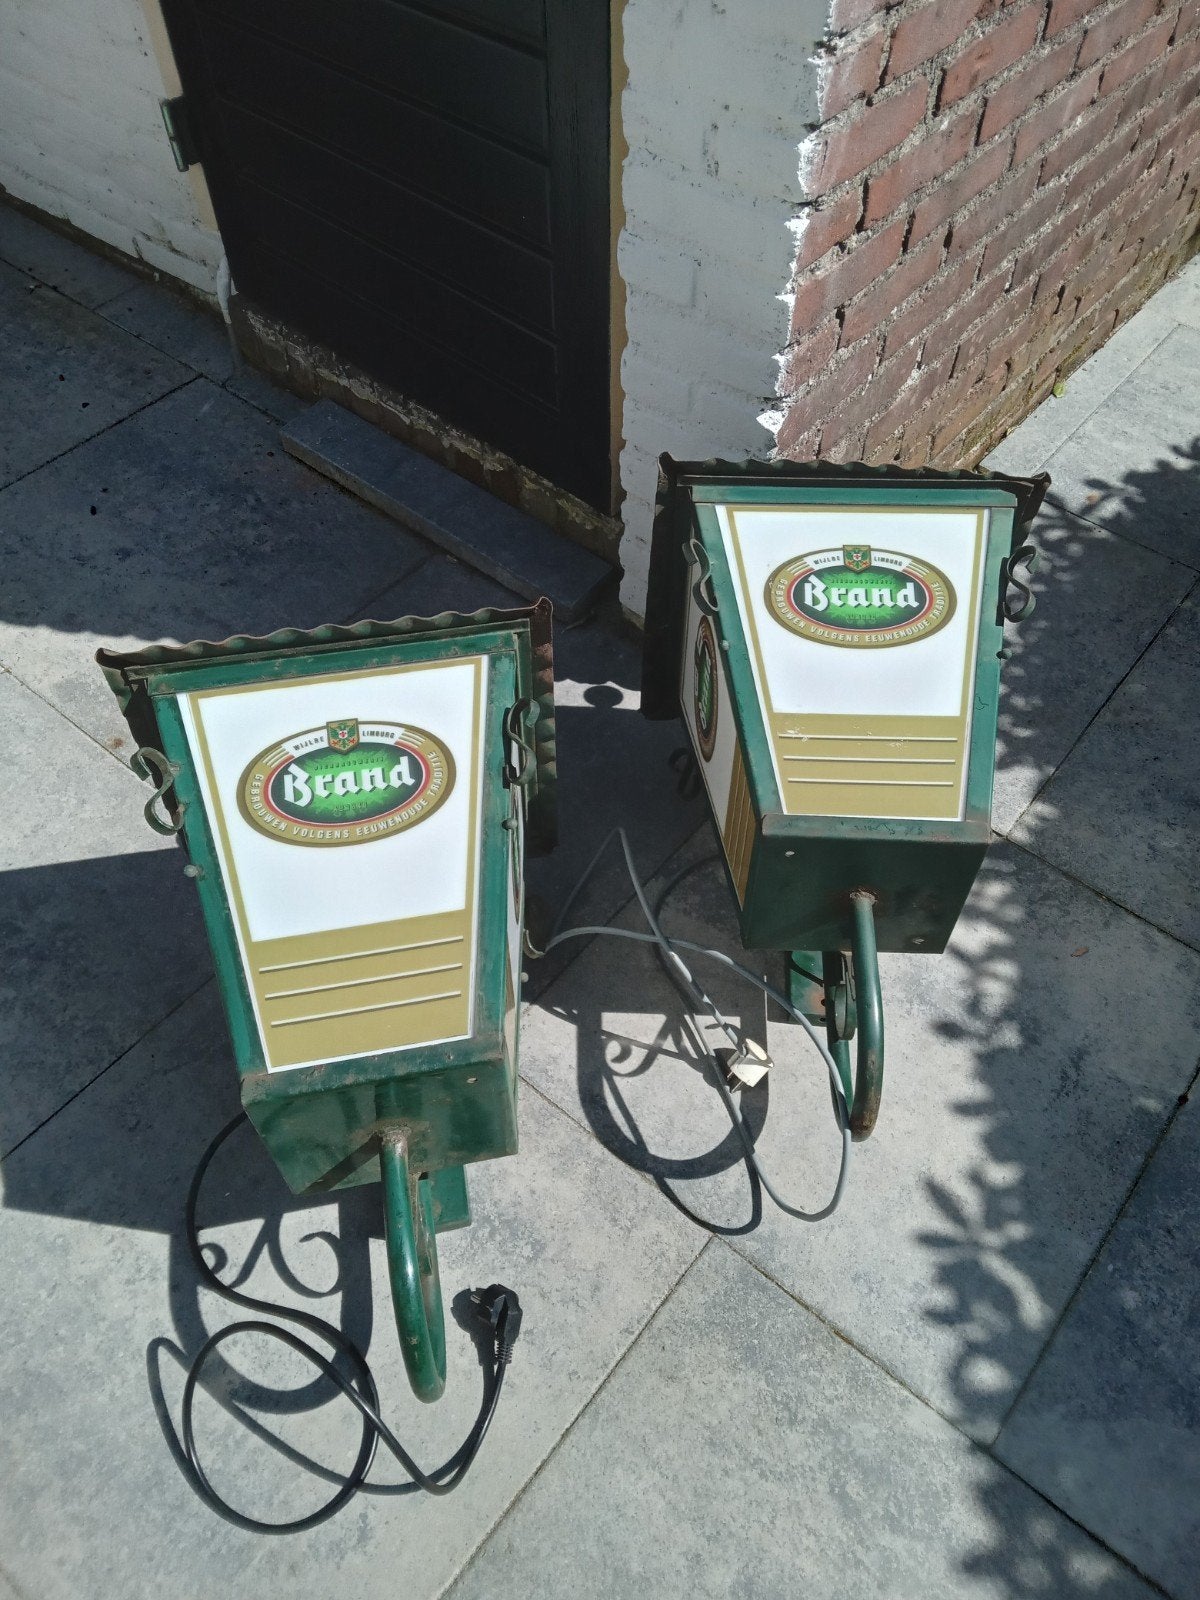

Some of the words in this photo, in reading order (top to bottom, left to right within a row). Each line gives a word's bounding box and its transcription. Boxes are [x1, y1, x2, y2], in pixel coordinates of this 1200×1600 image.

[804, 574, 920, 612] Brand
[810, 626, 859, 642] VOLGENS
[362, 729, 395, 739] LIMBURG
[283, 755, 416, 808] Brand
[250, 773, 288, 831] GEBROUWEN
[292, 826, 350, 839] VOLGENS
[356, 798, 429, 836] EEUWENOUDE
